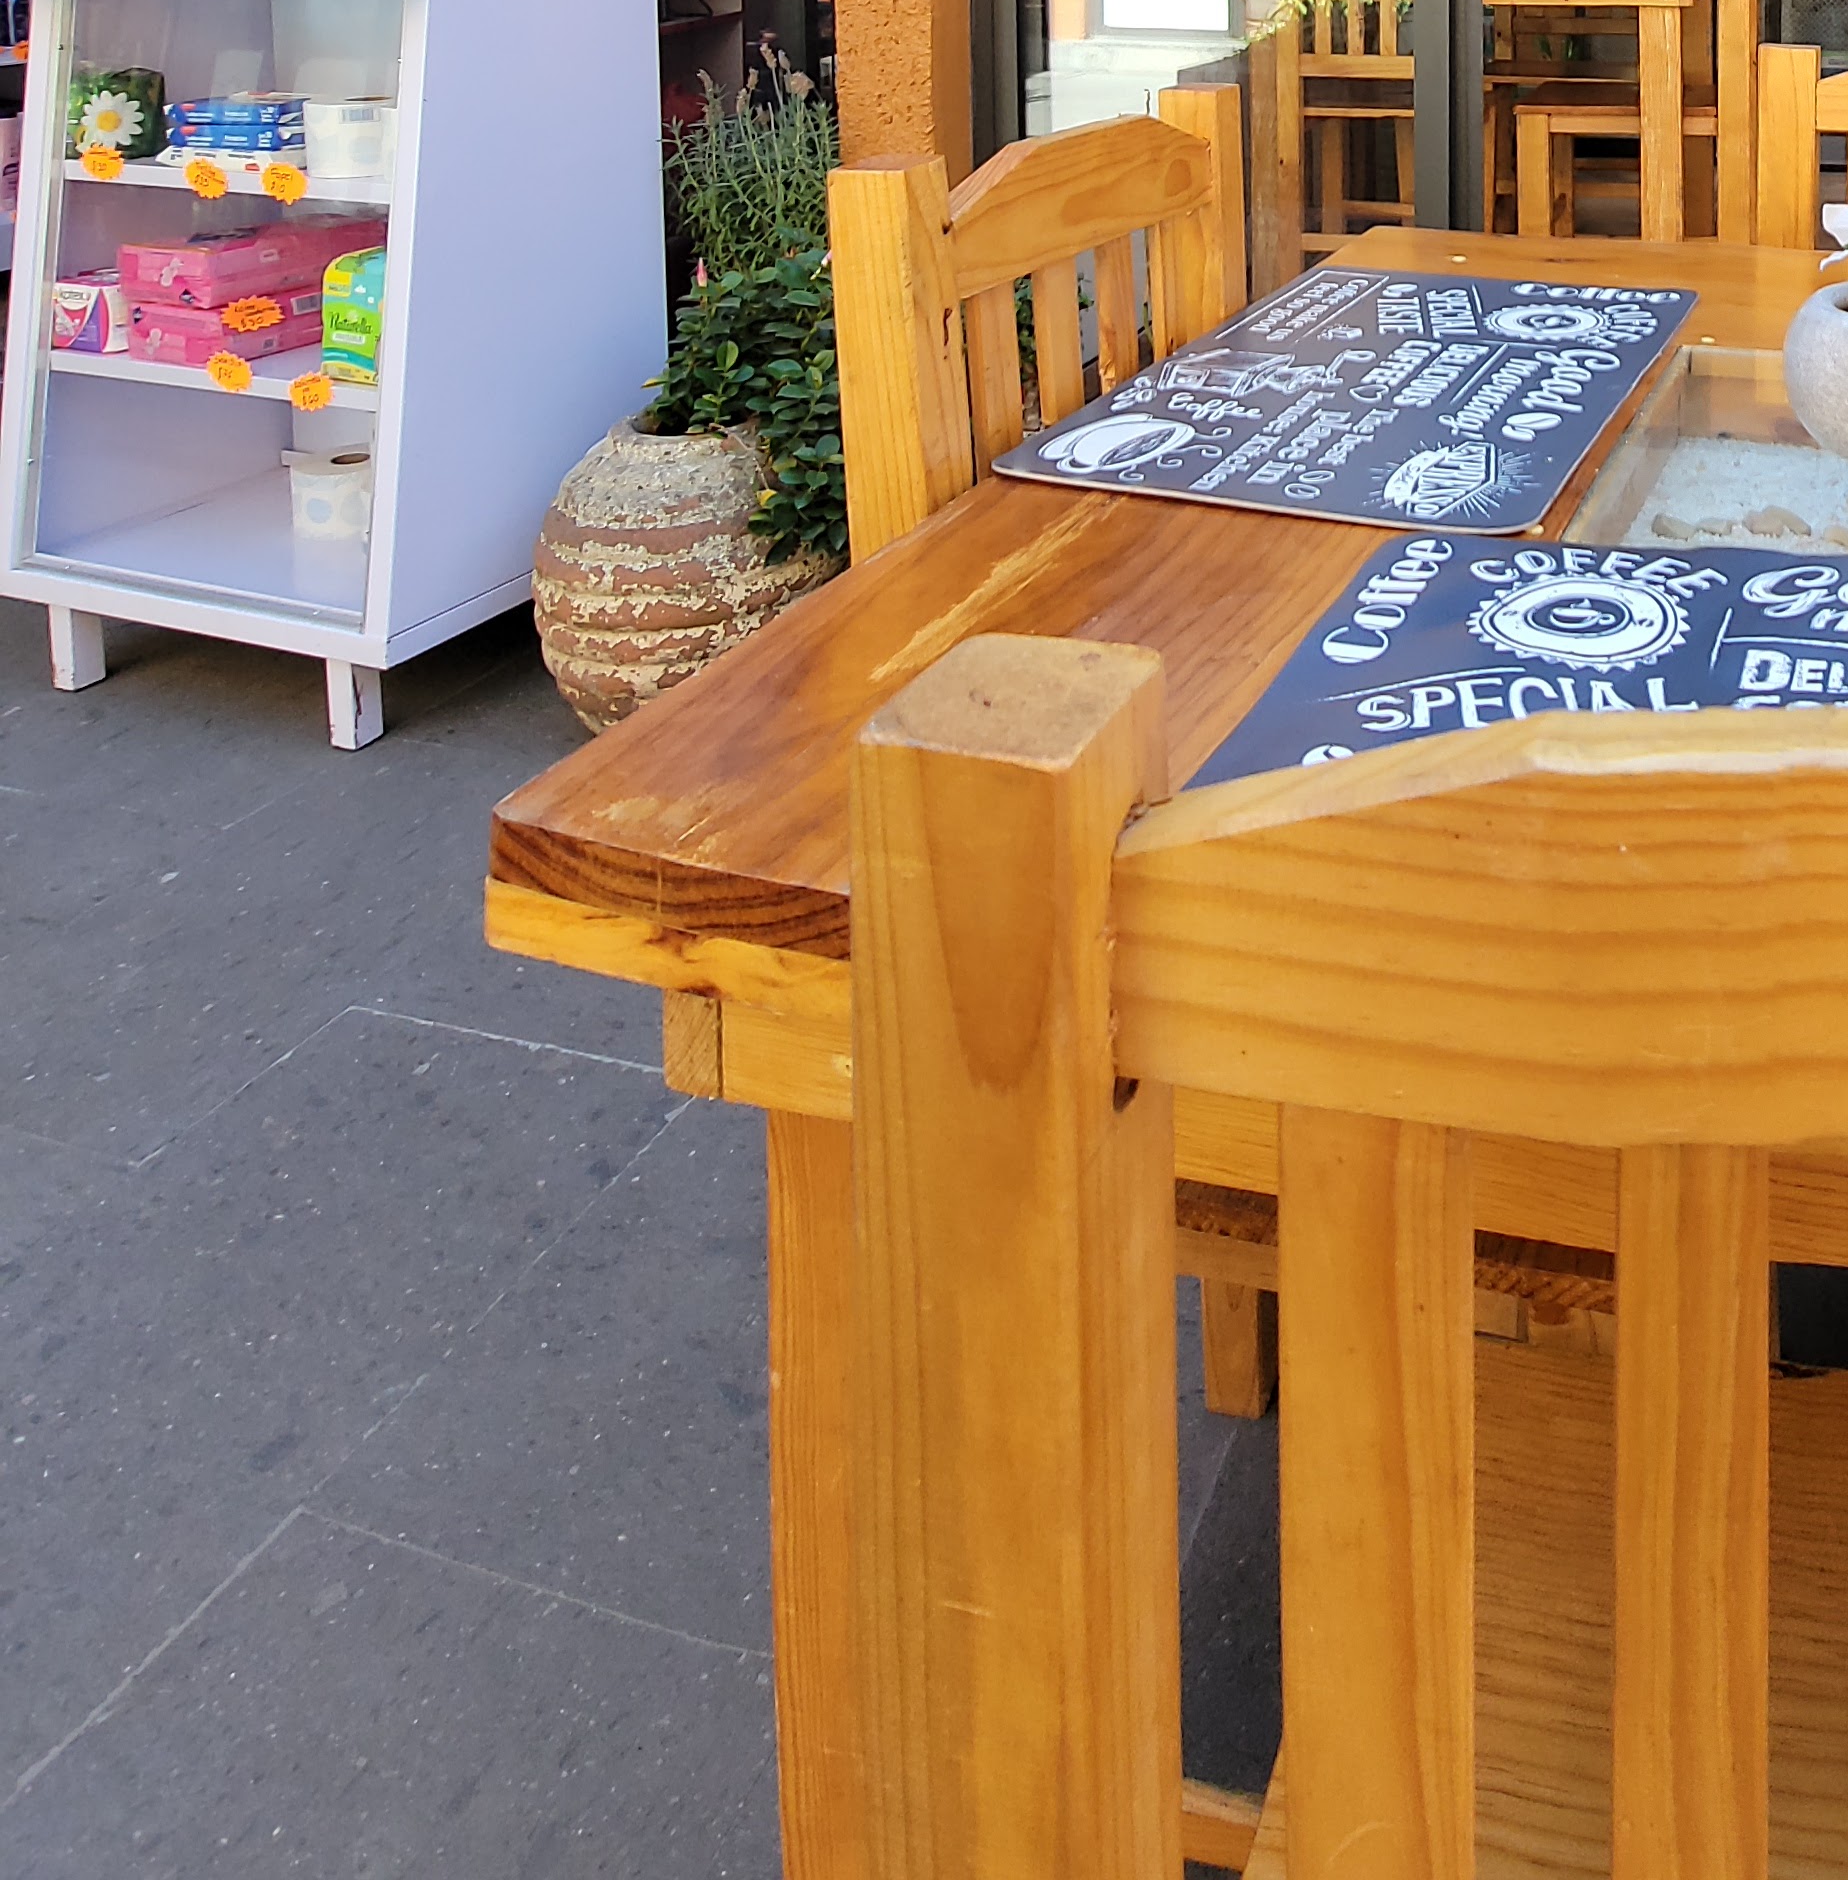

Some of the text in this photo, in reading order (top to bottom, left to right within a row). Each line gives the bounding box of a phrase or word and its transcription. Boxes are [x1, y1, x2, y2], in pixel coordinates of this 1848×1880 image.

[1303, 282, 1338, 298] feel
[1322, 280, 1368, 305] Coffee
[1431, 289, 1477, 338] SPECIAL
[1249, 308, 1293, 333] good
[1286, 304, 1329, 328] make
[1378, 297, 1421, 335] TASTE
[1358, 340, 1443, 385] COFFEE
[1390, 344, 1485, 408] DELICIOUS
[1526, 349, 1621, 411] Good
[1469, 547, 1729, 600] COFFEE
[1322, 539, 1454, 664] Coffee
[1356, 676, 1698, 732] SPECIAL
